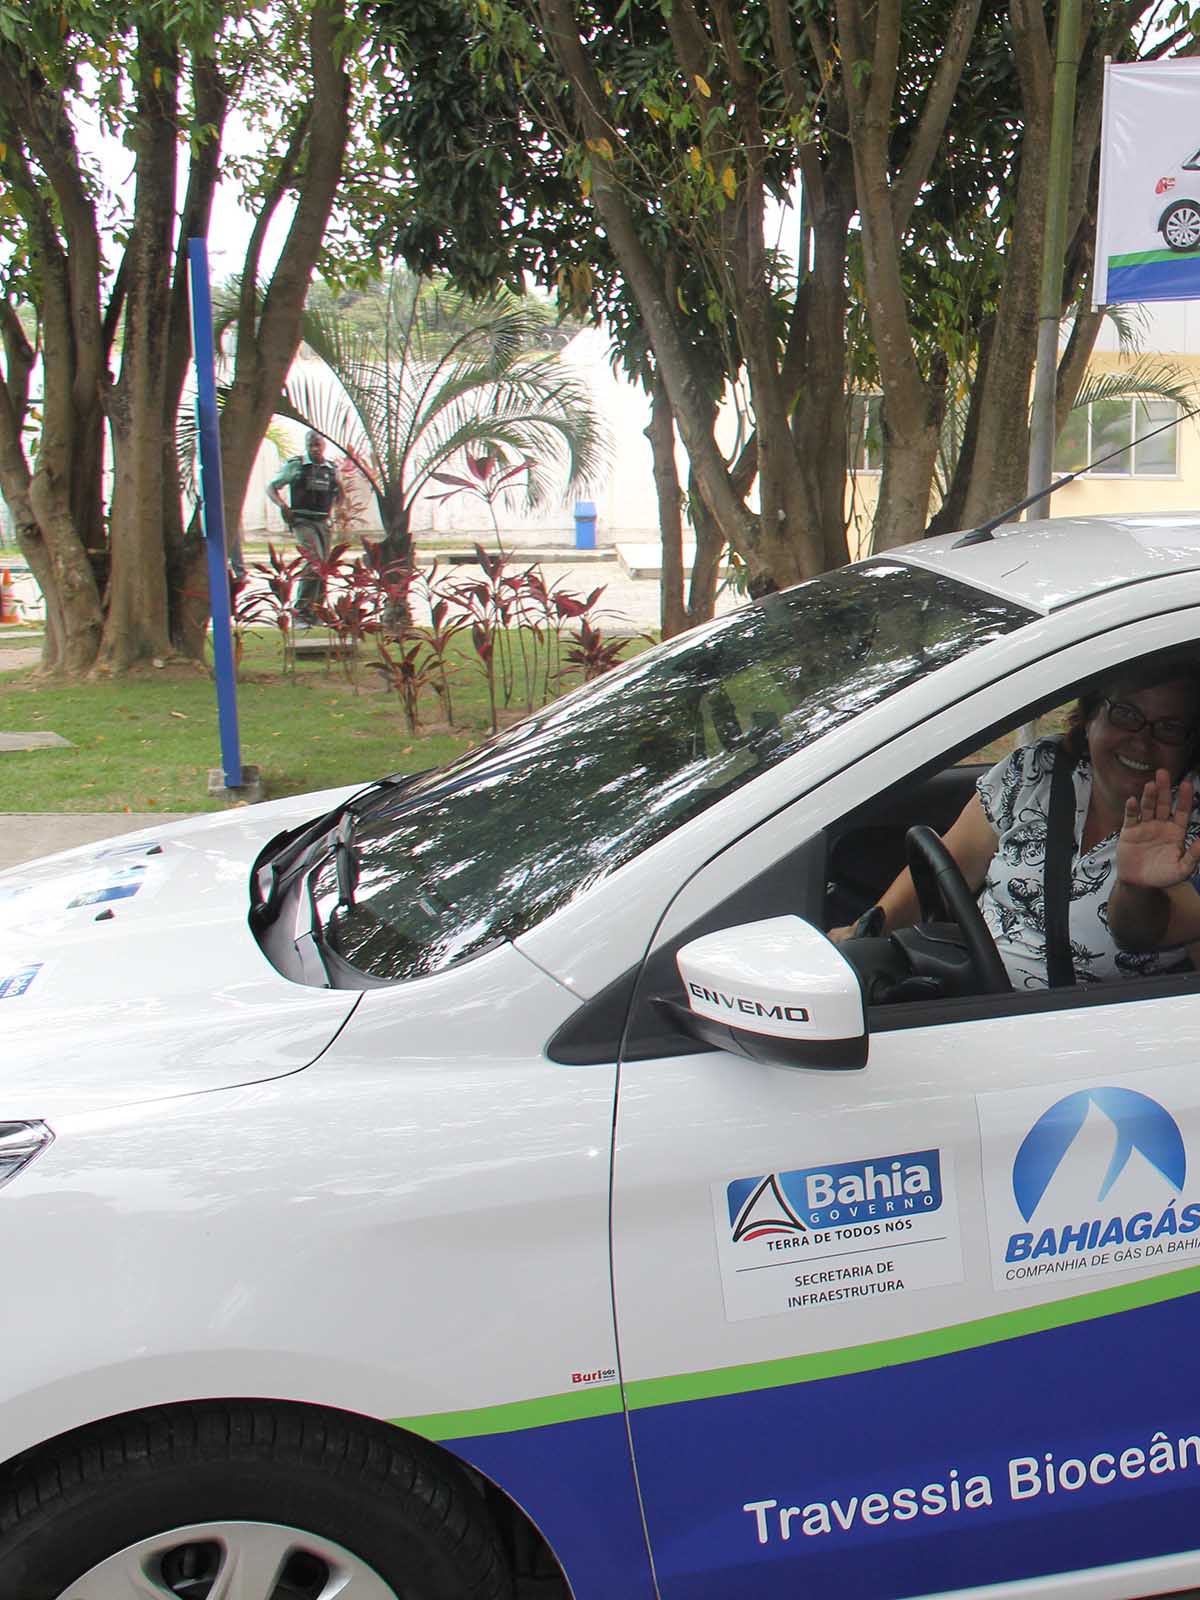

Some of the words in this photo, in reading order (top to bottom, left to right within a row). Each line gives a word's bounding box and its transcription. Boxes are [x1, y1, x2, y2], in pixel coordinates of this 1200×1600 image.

[688, 982, 810, 1023] ENVEMO
[804, 1160, 932, 1210] Bahia
[809, 1195, 934, 1224] GOVERNO
[767, 1236, 810, 1252] TERRA
[814, 1232, 832, 1245] DE
[835, 1225, 881, 1241] TODOS
[885, 1218, 913, 1234] NÓS
[794, 1265, 874, 1288] SECRETARIA
[877, 1261, 895, 1274] DE
[1005, 1257, 1088, 1282] COMPANHIA
[1091, 1253, 1111, 1267] DE
[1113, 1246, 1142, 1263] GÁS
[1145, 1245, 1164, 1257] DA
[788, 1279, 905, 1309] INFRAESTRUTURA
[743, 1468, 993, 1545] Travessia
